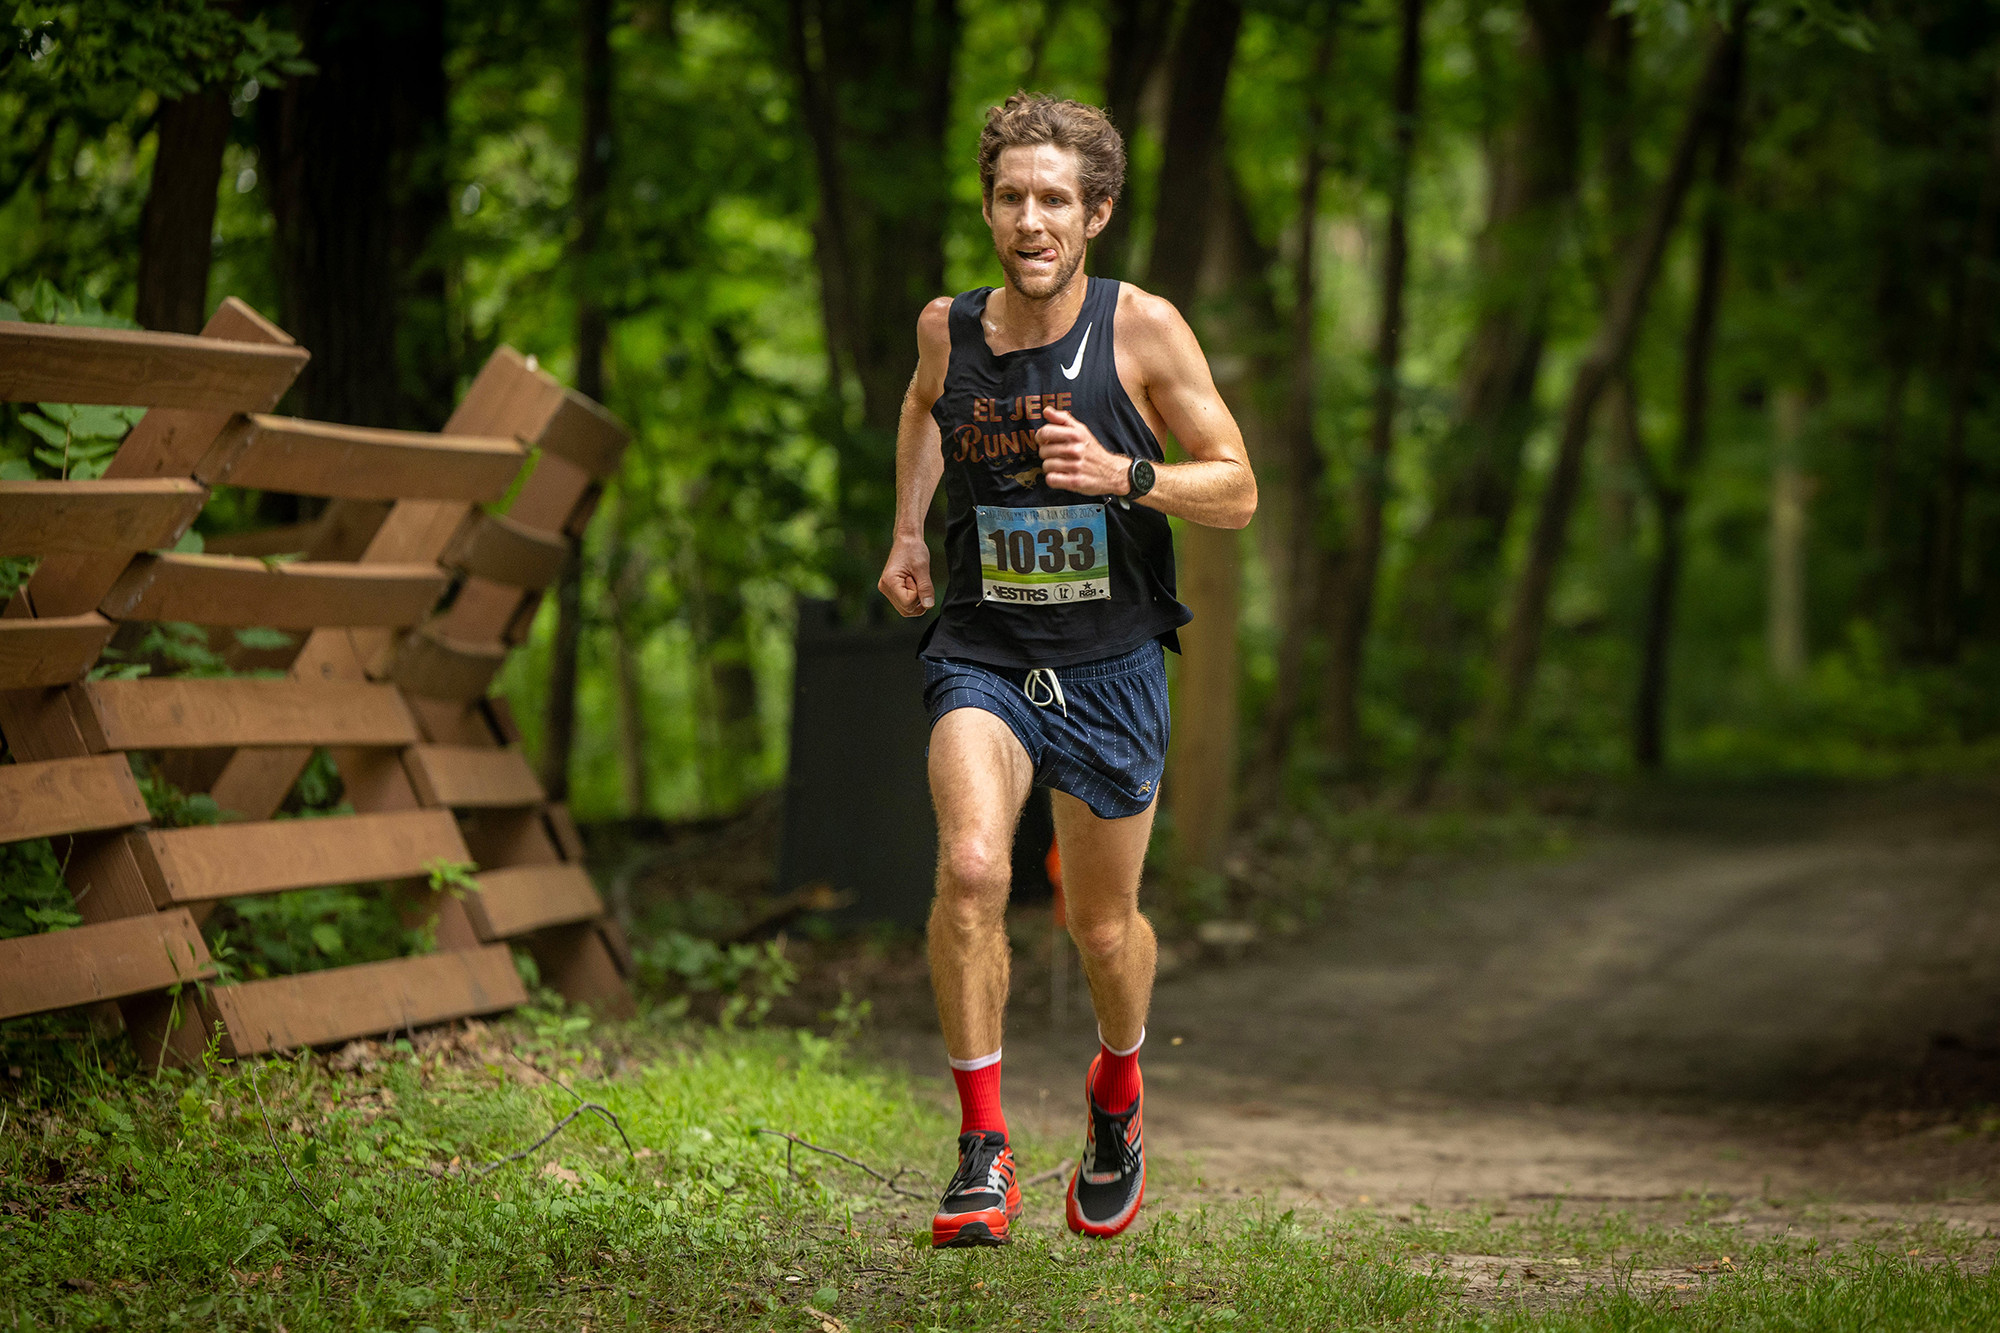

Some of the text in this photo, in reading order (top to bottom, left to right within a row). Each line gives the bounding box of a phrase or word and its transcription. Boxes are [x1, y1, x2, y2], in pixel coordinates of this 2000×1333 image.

[973, 397, 1003, 423] EL
[953, 424, 1039, 463] RUNN
[988, 527, 1096, 575] 1033
